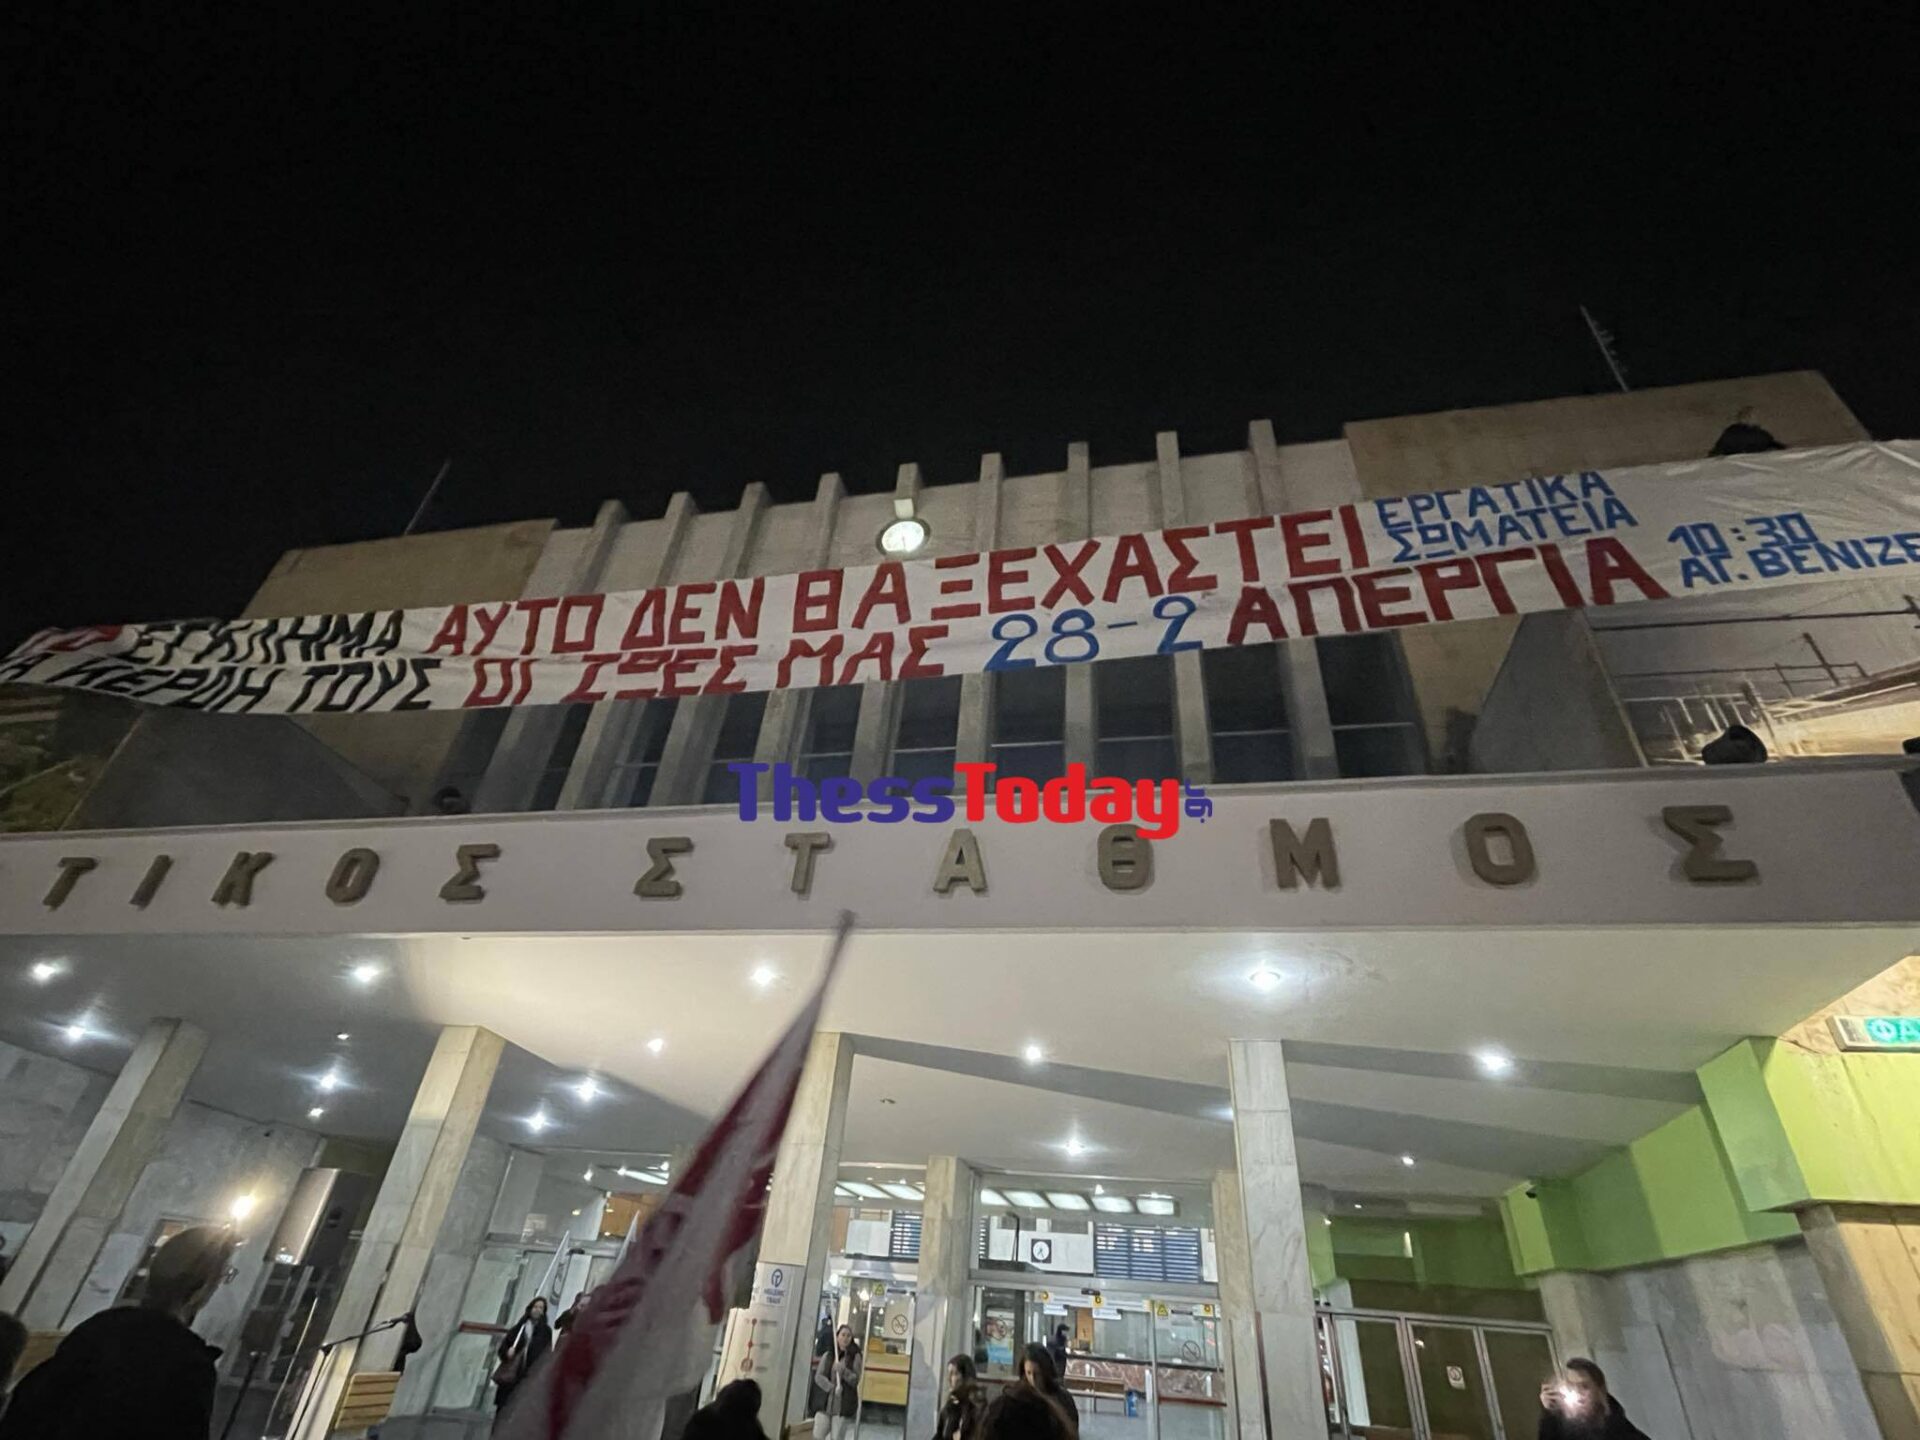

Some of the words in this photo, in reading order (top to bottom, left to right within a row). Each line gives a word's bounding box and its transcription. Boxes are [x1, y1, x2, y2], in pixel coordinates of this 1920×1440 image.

[1375, 471, 1616, 530] ΕΡΓΑΤΙΚΑ
[1387, 498, 1639, 564] ΣΩΜΑΤΕΙΑ
[1667, 512, 1820, 557] 10:30
[45, 656, 287, 713] ΚΕΡΔΗ
[286, 657, 442, 713] ΤΟΥΣ
[463, 657, 544, 708] ΟΙ
[560, 645, 759, 703] ΖΩΕΣ
[776, 625, 949, 689] ΜΑΣ
[983, 595, 1203, 672] 28-2
[1226, 533, 1671, 646] ΑΠΕΡΓΙΑ
[106, 609, 404, 665] ΕΓΚΛΗΜΑ
[423, 593, 607, 656] ΑΥΤΟ
[621, 576, 765, 650] ΔΕΝ
[791, 561, 912, 634] ΘΑ
[930, 504, 1370, 620] ΞΕΧΑΣΤΕΙ
[633, 805, 1760, 900] ΣΤΑΘΜΟΣ
